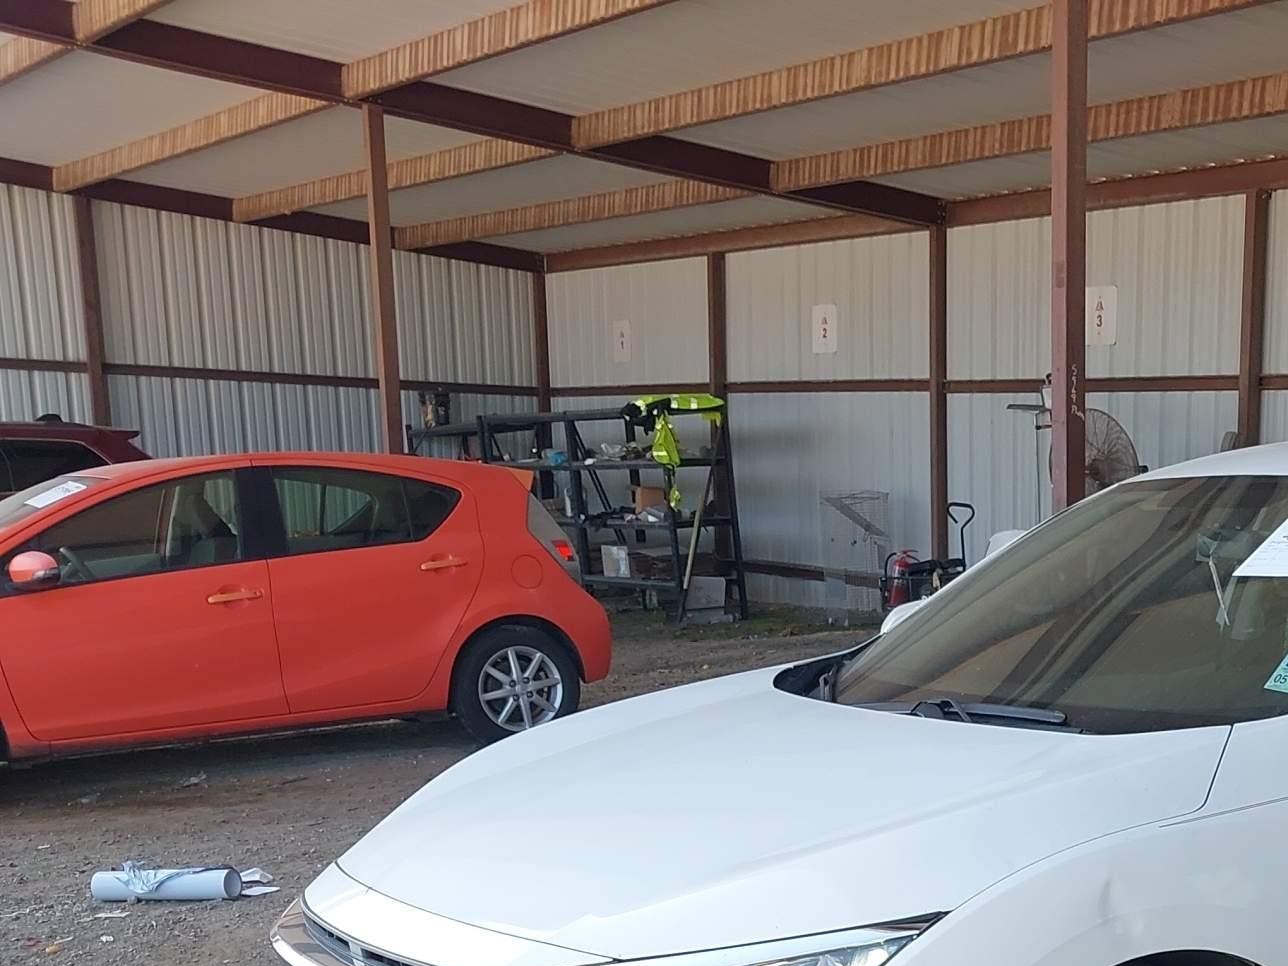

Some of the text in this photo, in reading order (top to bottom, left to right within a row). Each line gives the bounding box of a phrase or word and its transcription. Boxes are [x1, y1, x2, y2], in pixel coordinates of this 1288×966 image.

[1095, 314, 1103, 328] 3
[822, 327, 828, 339] 2
[1273, 673, 1288, 684] 05
